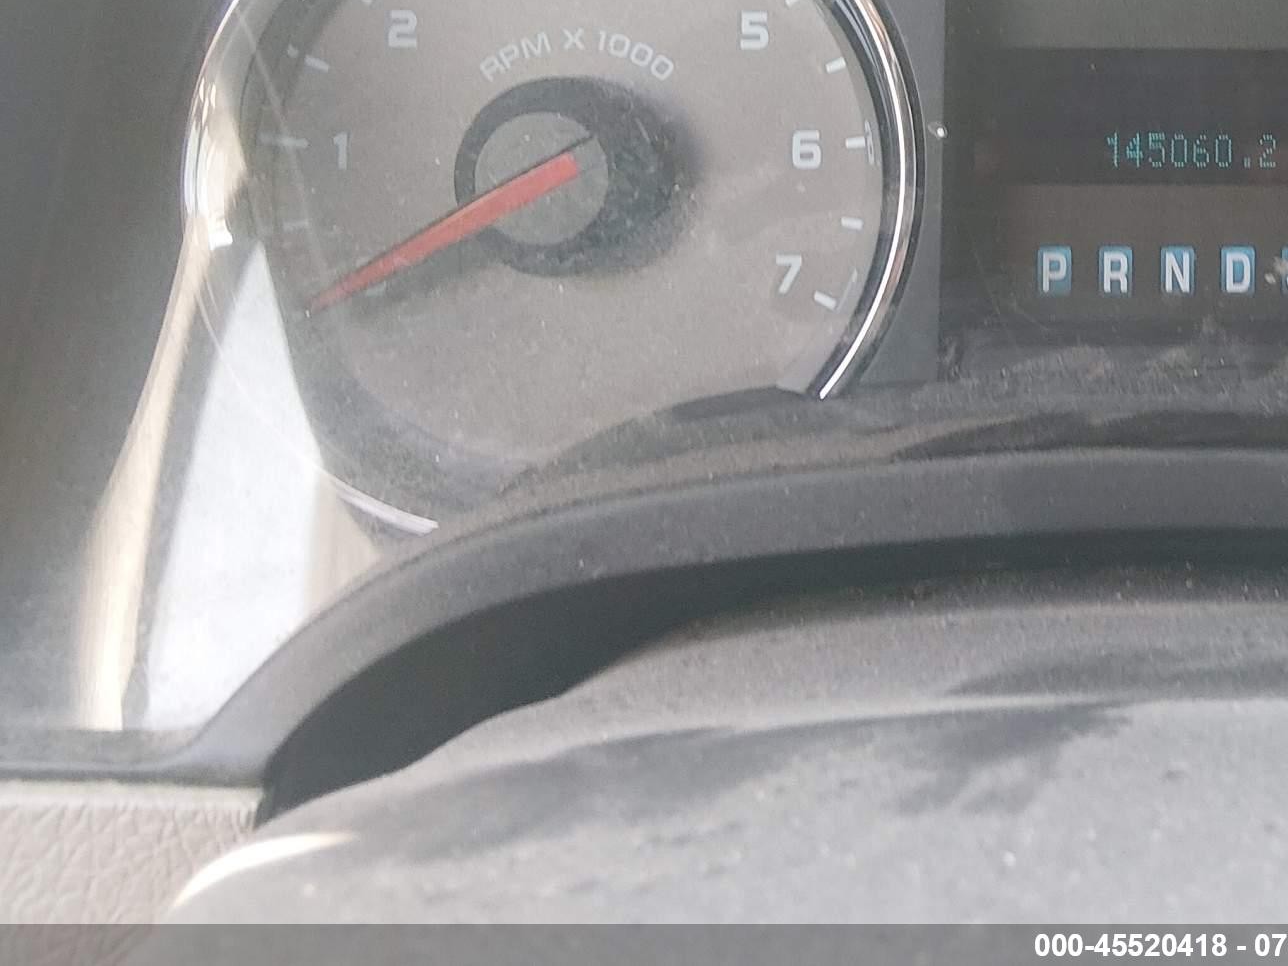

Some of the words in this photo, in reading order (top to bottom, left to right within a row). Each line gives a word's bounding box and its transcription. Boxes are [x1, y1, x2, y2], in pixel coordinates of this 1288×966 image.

[387, 10, 418, 49] 2
[740, 12, 769, 49] 5
[479, 32, 552, 82] RPM
[562, 28, 586, 51] X
[599, 30, 675, 81] 1000
[332, 133, 350, 169] 1
[791, 130, 821, 168] 6
[1106, 132, 1277, 169] 145060.2
[775, 254, 803, 294] 7
[1042, 251, 1068, 294] P
[1103, 251, 1129, 294] R
[1164, 251, 1191, 294] N
[1225, 251, 1252, 294] D
